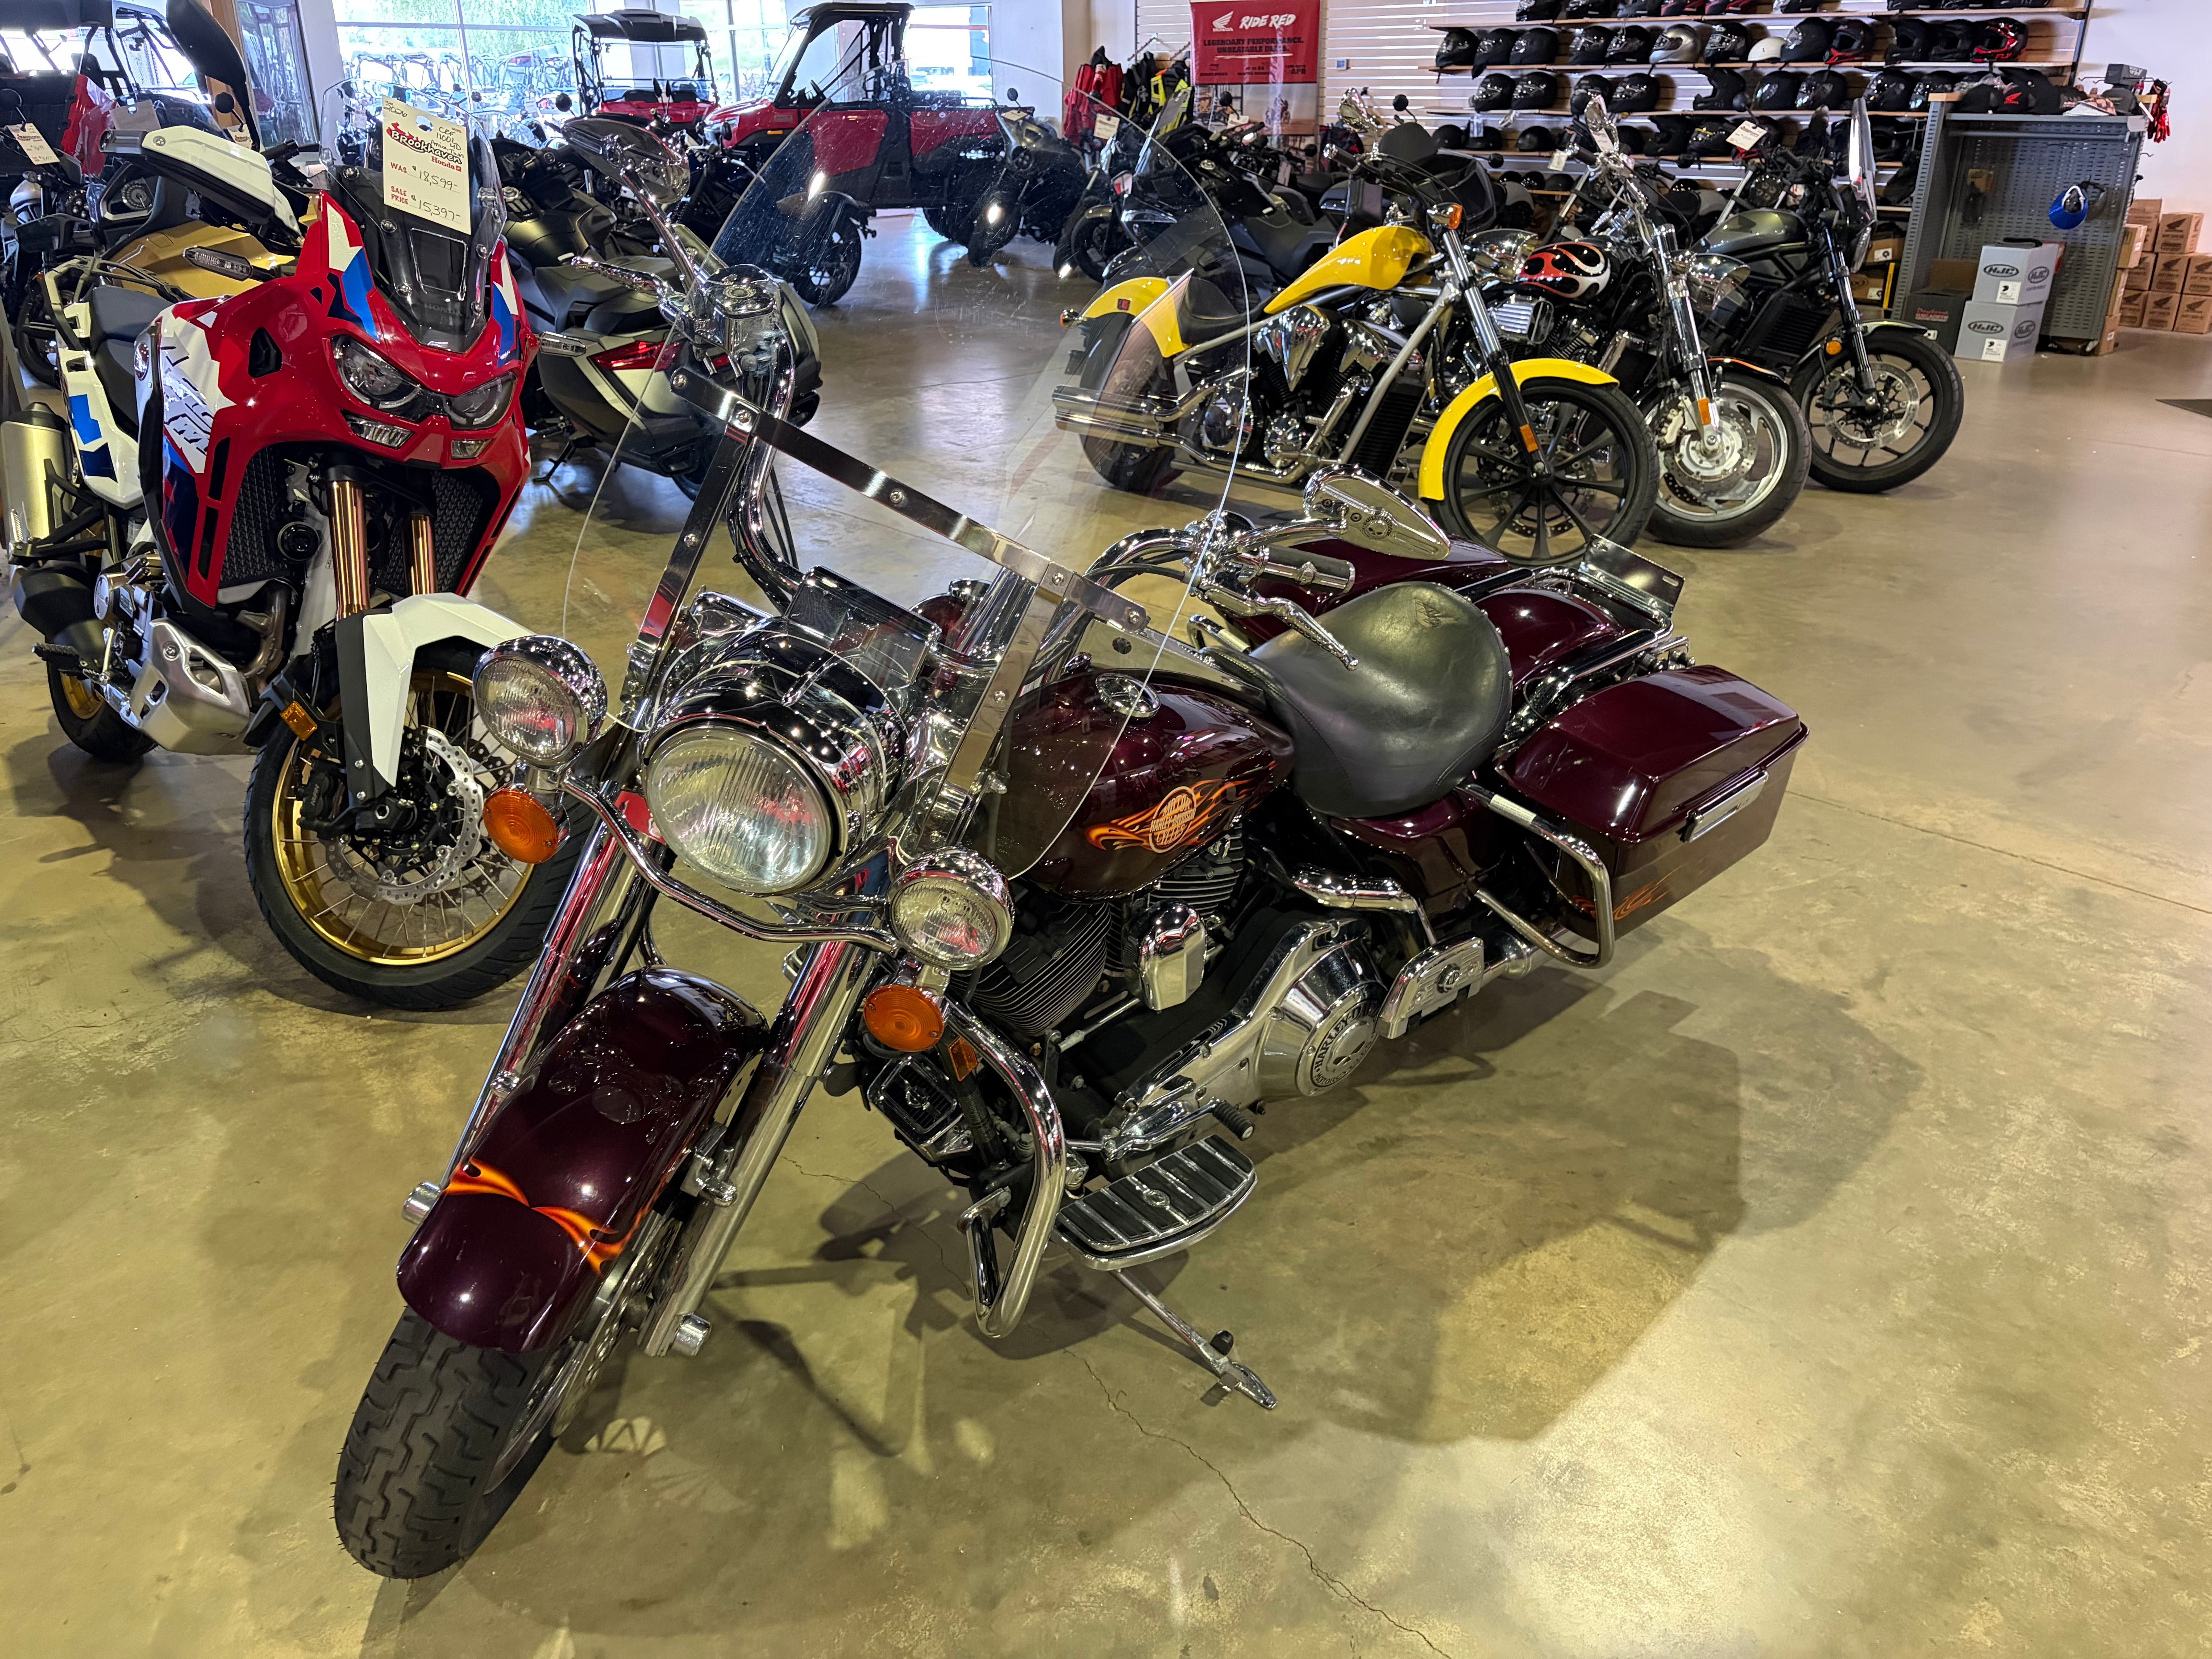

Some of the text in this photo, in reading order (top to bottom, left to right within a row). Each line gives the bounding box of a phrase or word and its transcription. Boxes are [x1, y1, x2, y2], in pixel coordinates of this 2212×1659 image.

[1239, 14, 1297, 30] RIDE RED
[383, 104, 407, 117] 2026
[390, 161, 407, 173] WAS
[431, 156, 455, 170] Honda
[391, 186, 407, 196] SALE
[391, 193, 409, 205] PRICE
[2031, 270, 2046, 280] HJC
[424, 303, 463, 317] HONDA
[1162, 795, 1192, 817] MOTOR
[1149, 808, 1197, 833] HARLEY-DAVIDSON
[1156, 824, 1185, 845] CYCLES
[1314, 1001, 1378, 1072] HARLEY-DAVI
